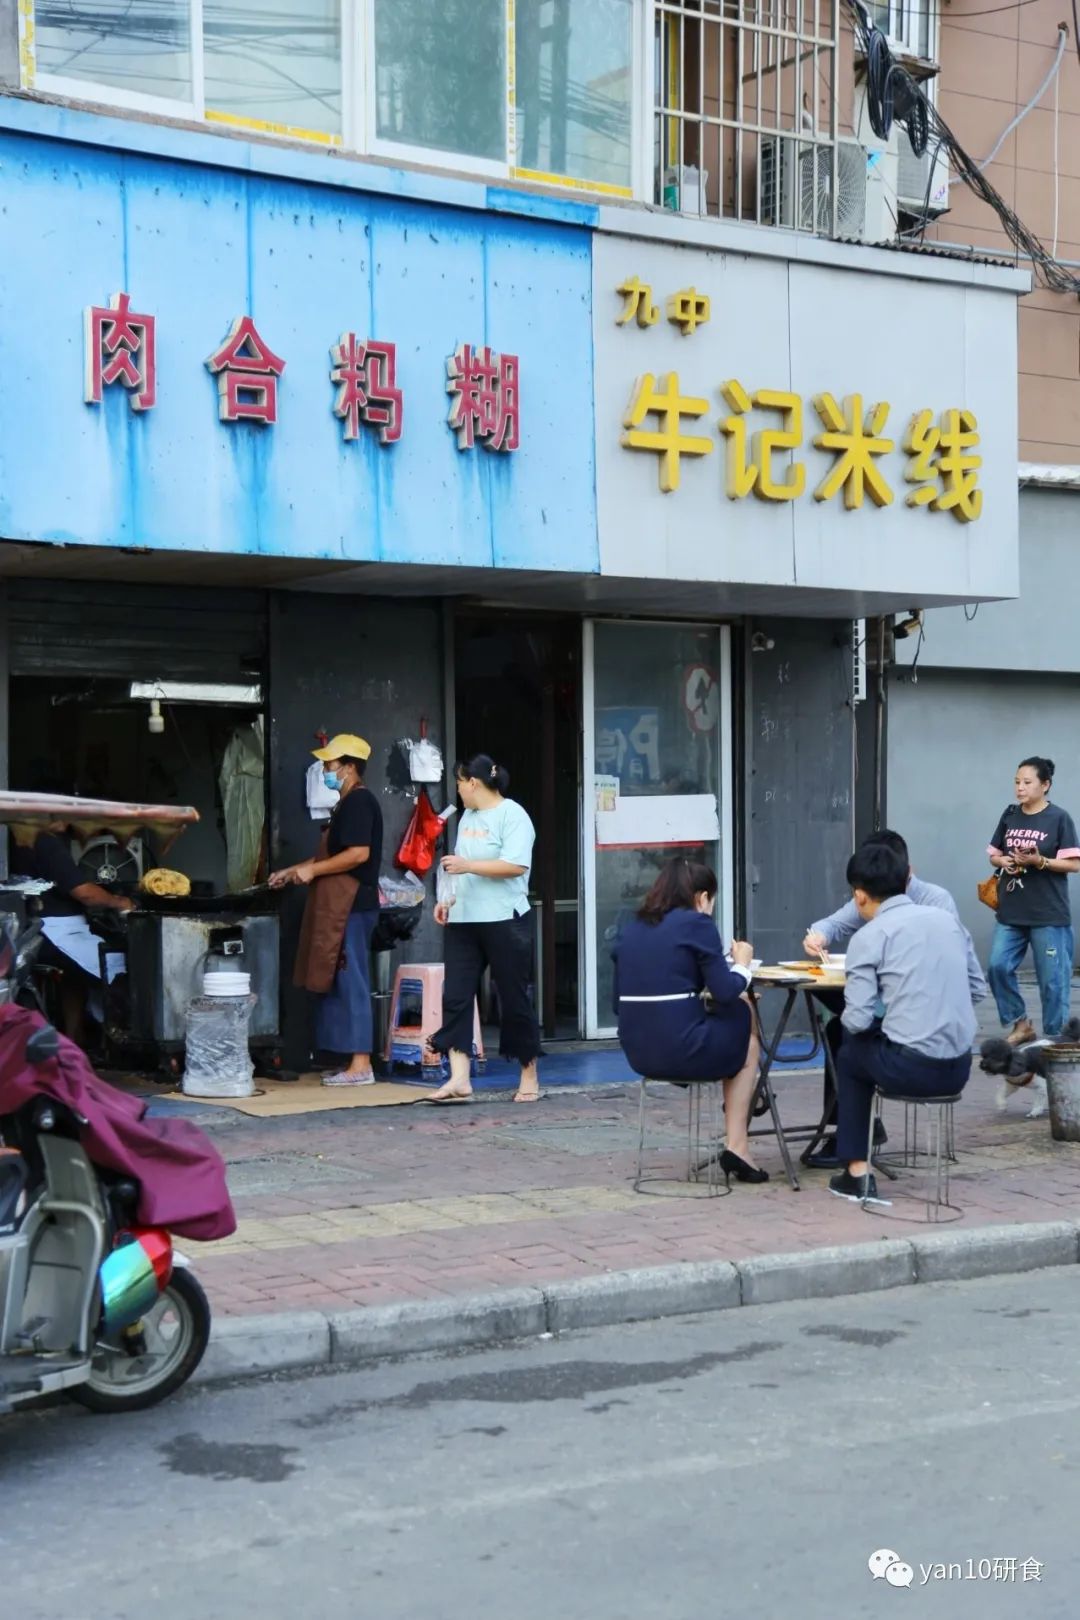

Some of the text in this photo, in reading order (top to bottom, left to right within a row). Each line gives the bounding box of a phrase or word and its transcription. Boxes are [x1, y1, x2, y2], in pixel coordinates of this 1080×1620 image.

[615, 274, 711, 336] 九中
[619, 370, 984, 524] 牛记米线
